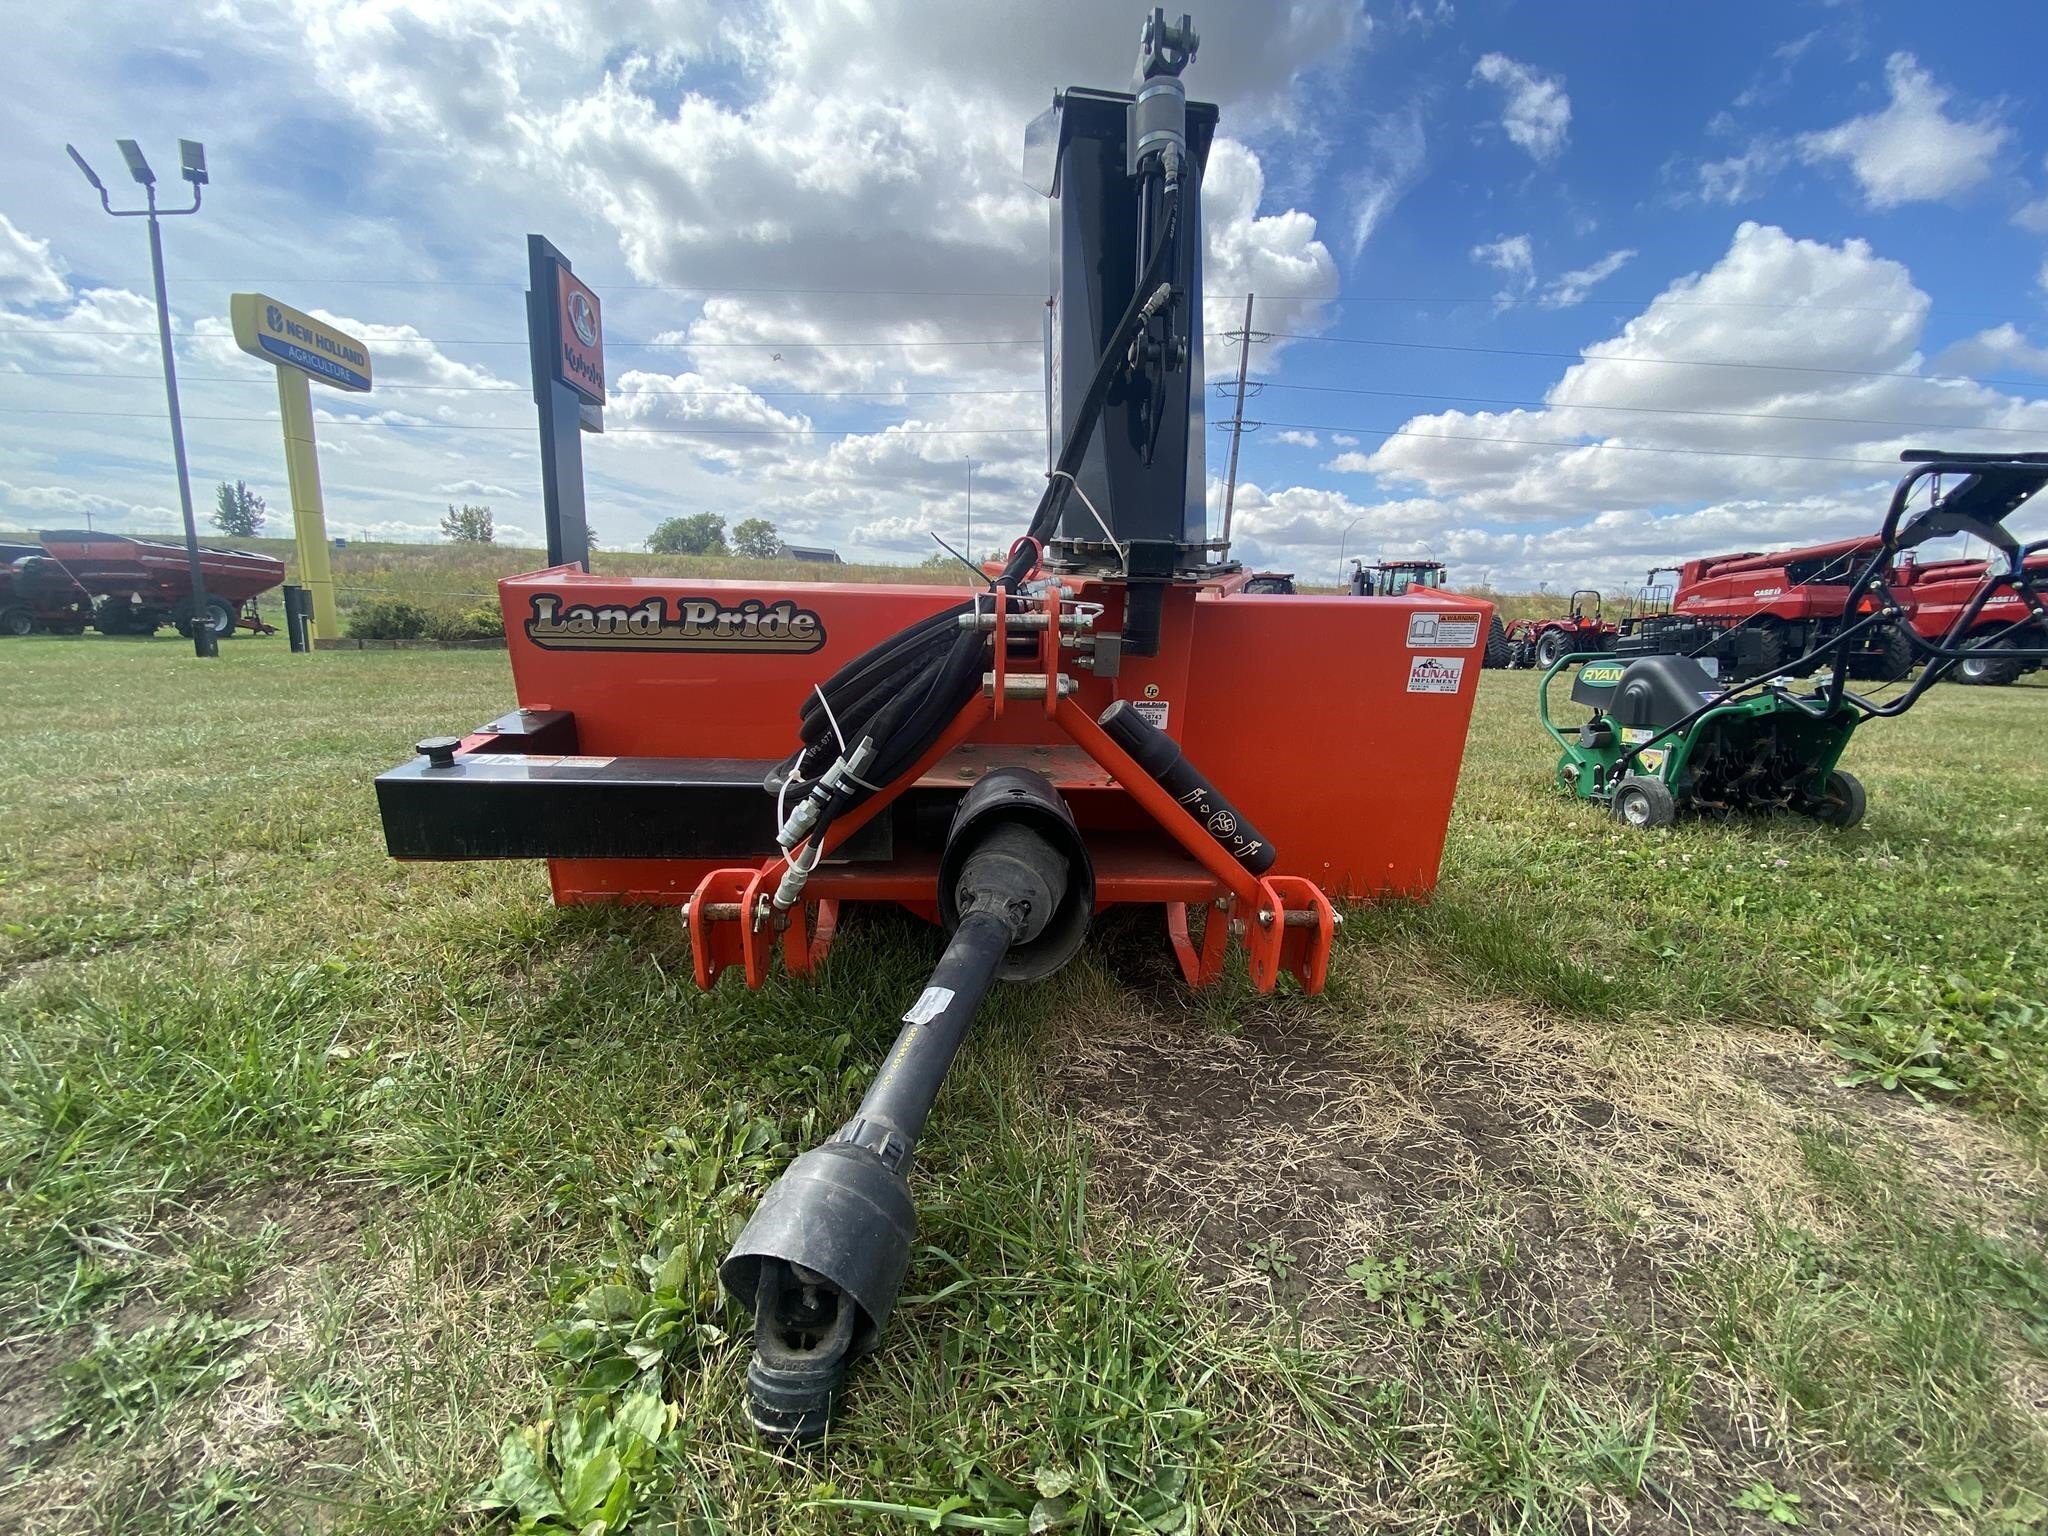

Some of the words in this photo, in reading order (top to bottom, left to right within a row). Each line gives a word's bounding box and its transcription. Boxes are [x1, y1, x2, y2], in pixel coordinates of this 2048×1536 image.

[286, 320, 312, 344] NEW
[316, 333, 364, 366] HOLLAND
[288, 346, 351, 381] AGRICULTURE
[564, 344, 603, 388] Kubota
[533, 597, 663, 636] Land
[680, 601, 816, 639] Pride
[1583, 669, 1625, 681] RYAN
